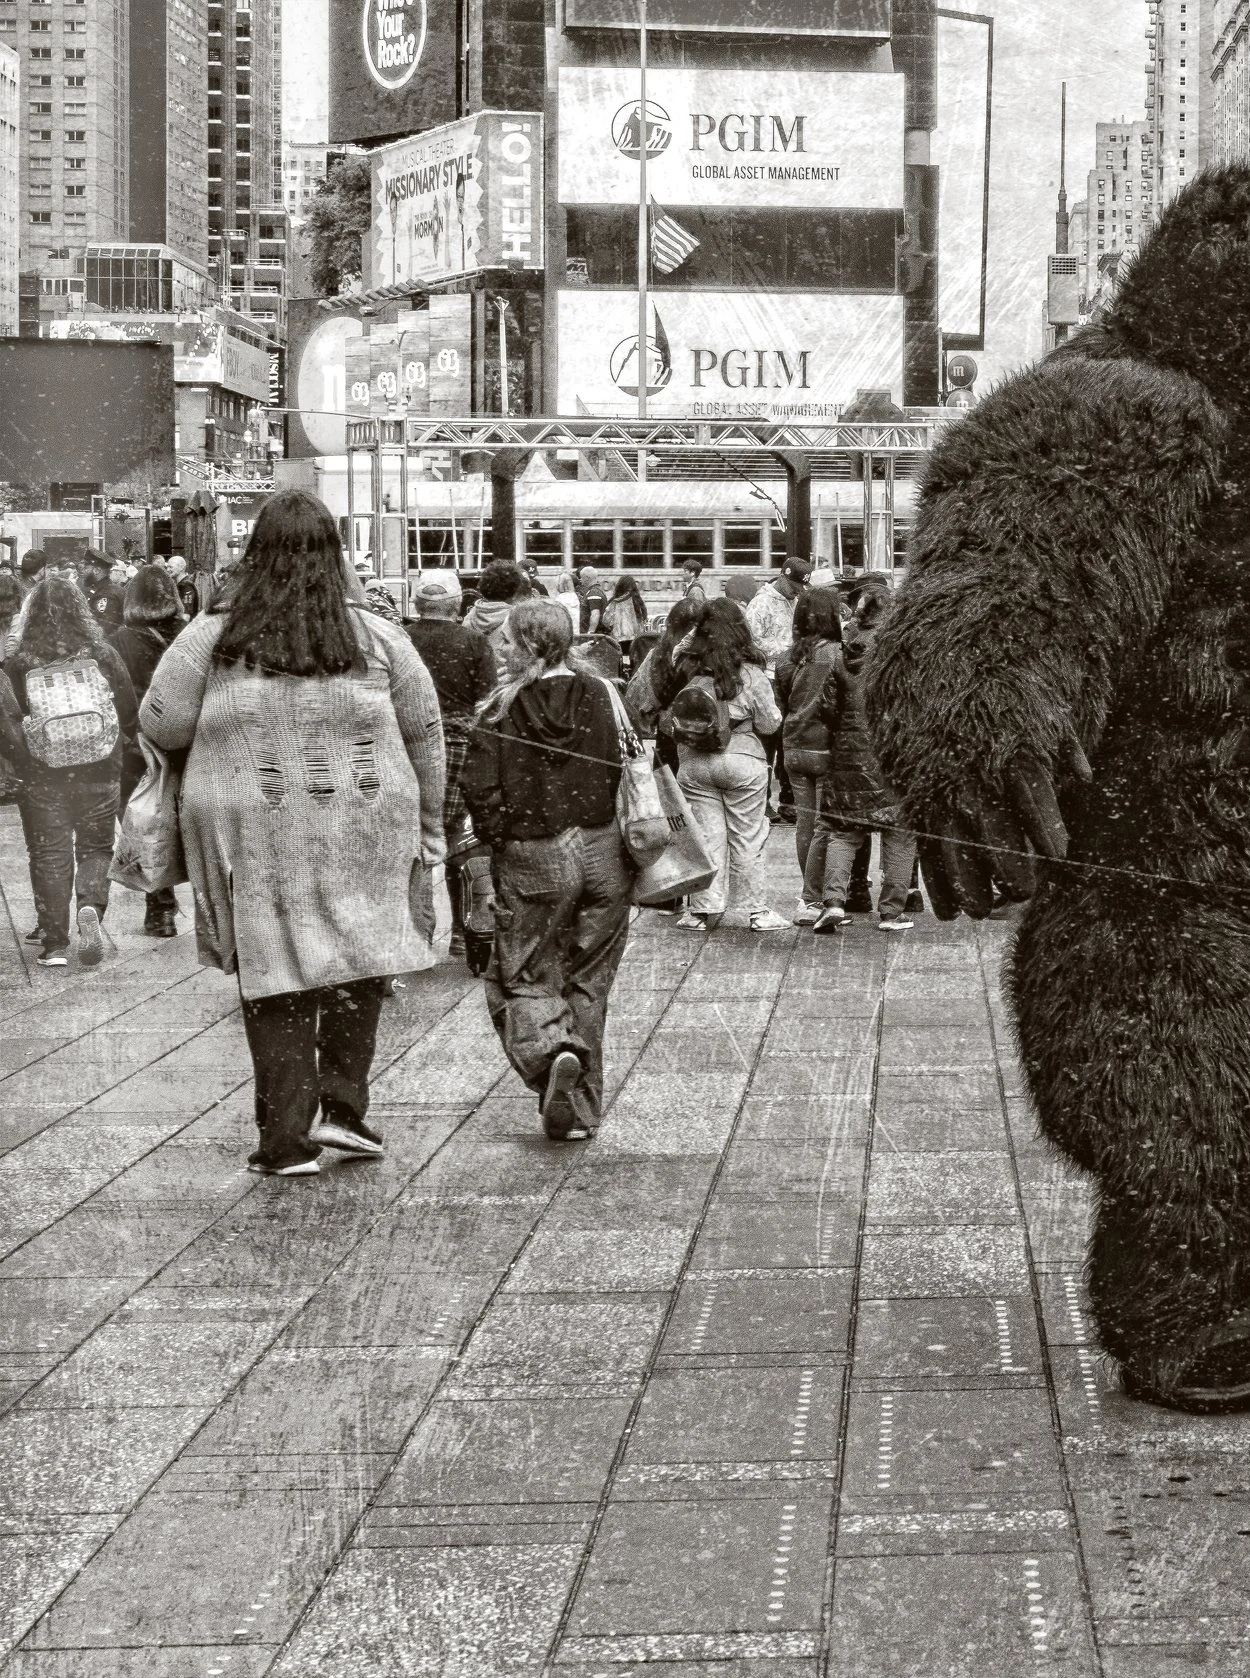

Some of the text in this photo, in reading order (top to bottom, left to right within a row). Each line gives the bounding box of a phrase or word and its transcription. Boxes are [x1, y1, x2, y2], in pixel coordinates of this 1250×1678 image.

[376, 10, 404, 39] Your
[377, 33, 415, 68] Rock?
[689, 114, 807, 152] PGIM
[385, 152, 474, 205] MISSIONARY STYLE
[502, 122, 531, 260] HELLO!
[692, 165, 840, 181] GLOBAL ASSET MANAGEMENT
[690, 349, 811, 389] PGIM
